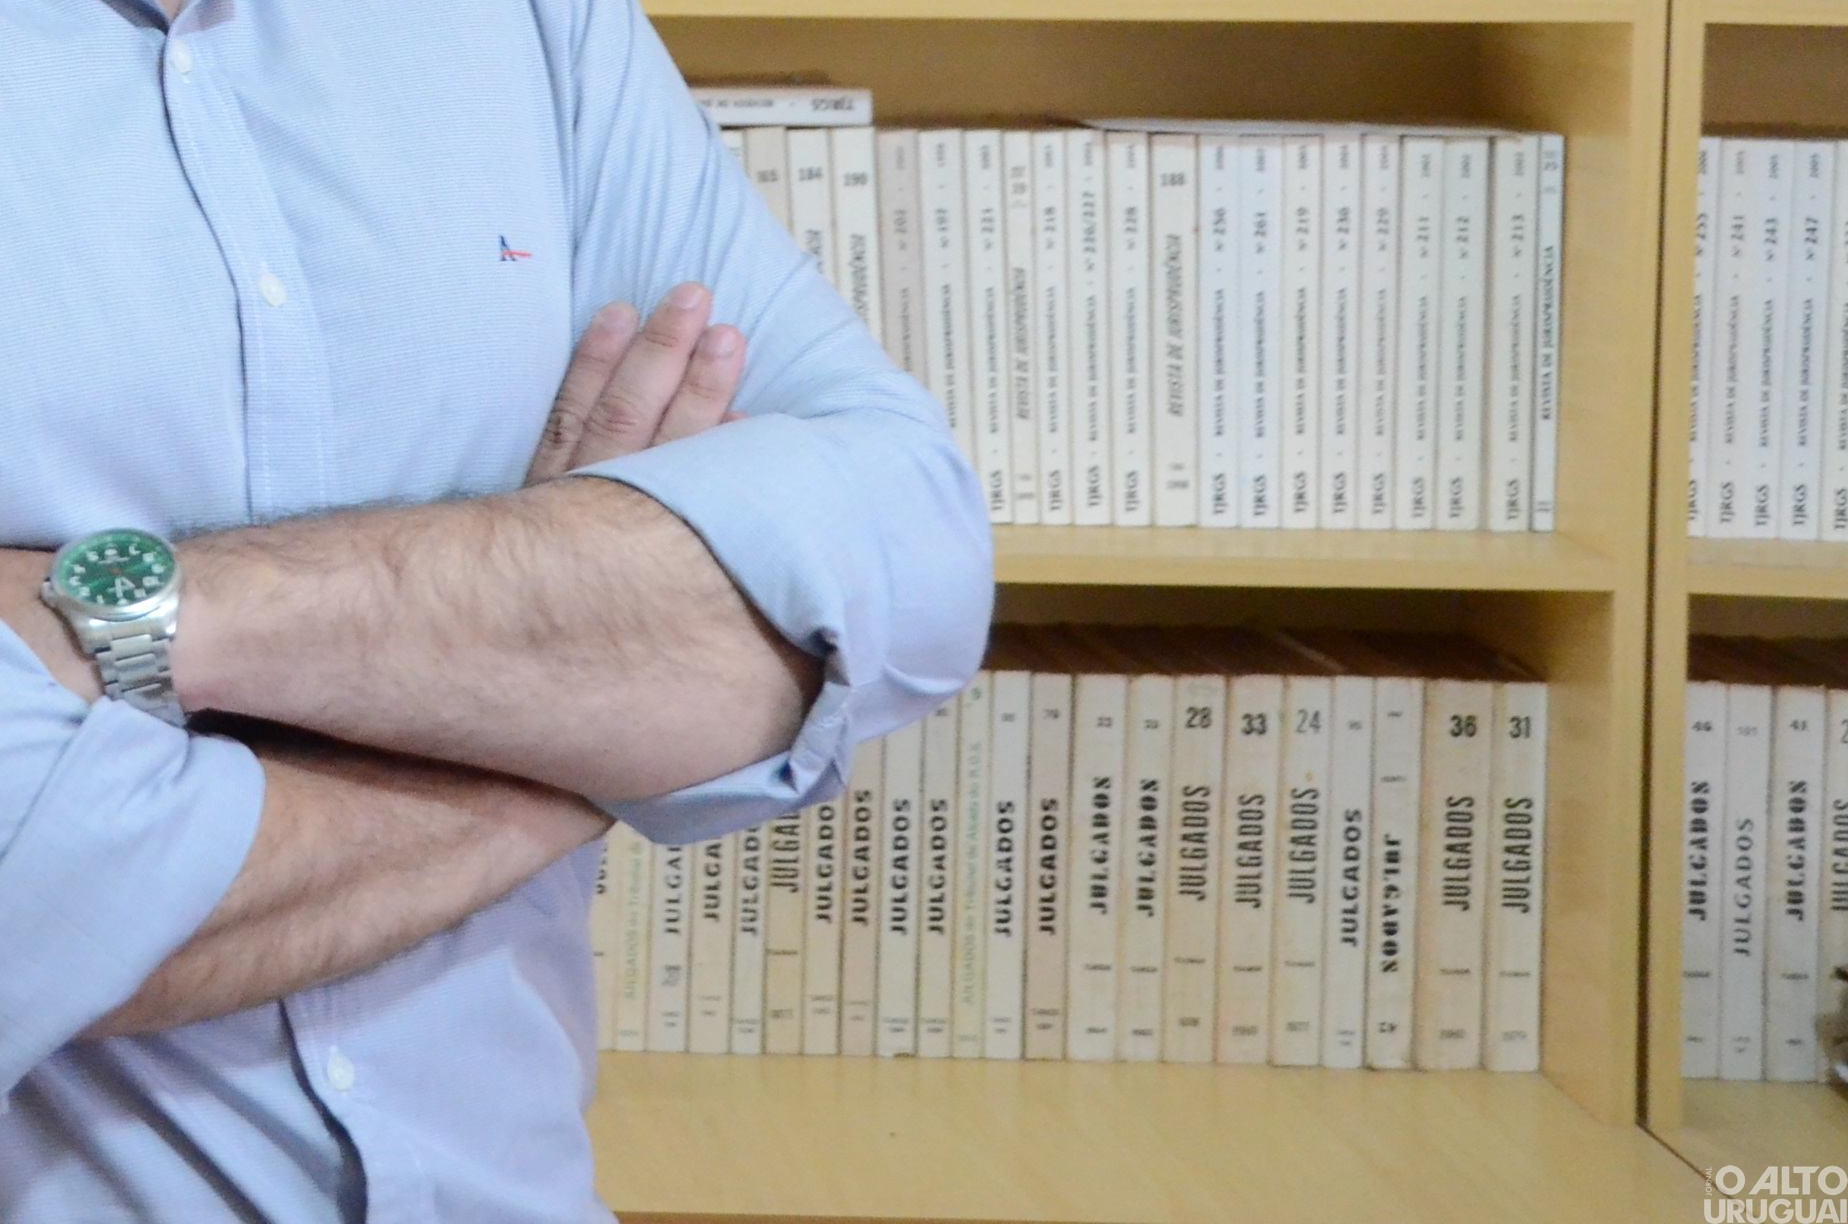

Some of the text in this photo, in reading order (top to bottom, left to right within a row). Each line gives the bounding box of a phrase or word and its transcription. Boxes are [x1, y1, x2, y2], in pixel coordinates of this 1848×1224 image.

[1293, 471, 1308, 514] TJRGS
[1720, 481, 1734, 524] TJRGS
[1755, 484, 1770, 526] TJRGS
[1793, 484, 1808, 526] TJRGS
[1185, 706, 1212, 729] 28
[1241, 713, 1268, 736] 33
[1295, 708, 1321, 733] 24
[1508, 716, 1532, 739] 31
[703, 837, 722, 922] JULGA
[814, 805, 834, 924] JULGADO
[851, 789, 872, 927] JULGADOS
[889, 798, 911, 936] JULGADOS
[927, 798, 949, 936] JULGADOS
[993, 800, 1015, 938] JULGADOS
[1038, 798, 1060, 936] JULGADOS
[1089, 777, 1113, 915] JULGADOS
[1136, 779, 1160, 918] JULGADOS
[1178, 785, 1212, 901] JULGADOS
[1234, 794, 1265, 909] JULGADOS
[1285, 788, 1319, 904] JULGADOS
[1340, 809, 1362, 948] JULGADOS
[1442, 796, 1474, 912] JULGADOS
[1501, 797, 1533, 914] JULGADOS
[1687, 781, 1710, 921] JULGADOS
[1733, 817, 1754, 957] JULGADOS
[1785, 781, 1807, 922] JULGADOS
[1380, 834, 1402, 974] JULGADOS
